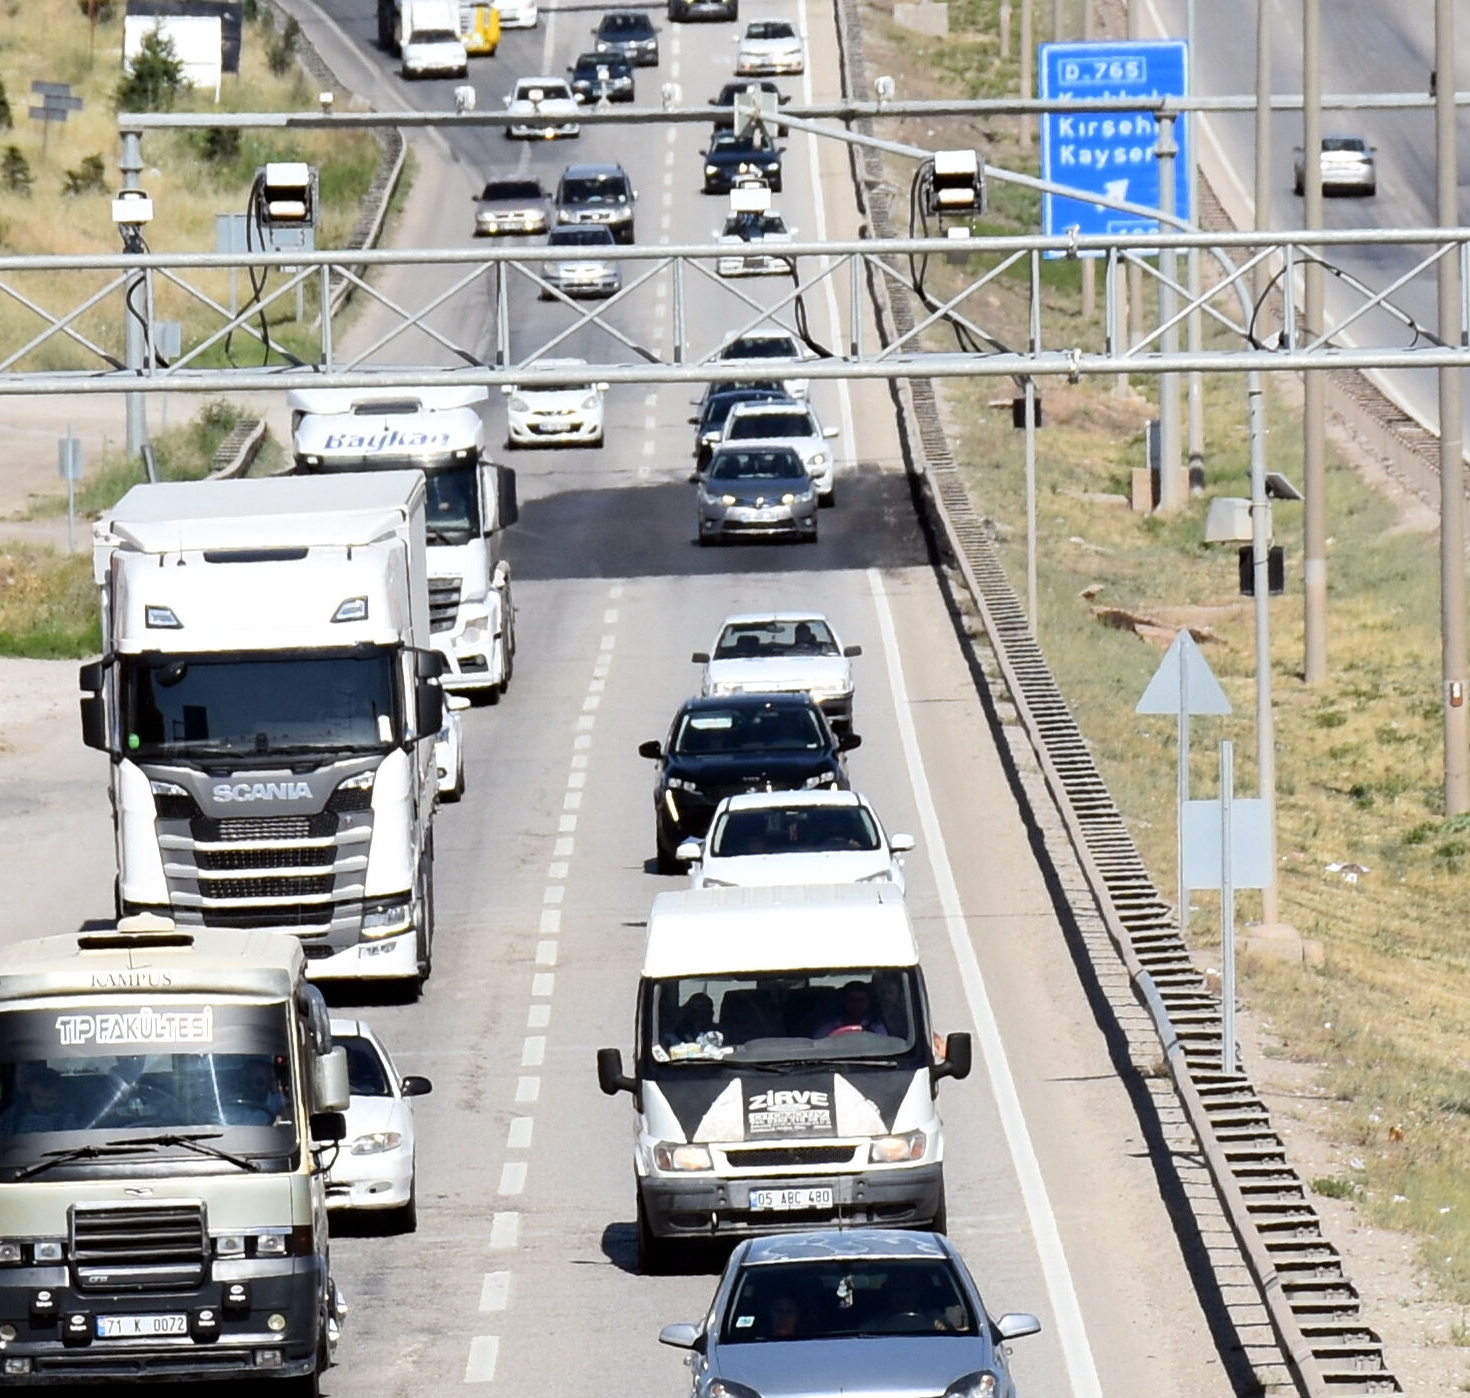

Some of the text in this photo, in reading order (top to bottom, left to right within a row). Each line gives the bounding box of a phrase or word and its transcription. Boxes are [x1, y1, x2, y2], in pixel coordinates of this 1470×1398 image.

[1065, 61, 1139, 81] D.765
[1061, 143, 1154, 169] Kayser
[324, 431, 450, 453] Baykan
[213, 782, 313, 802] SCANIA
[56, 1004, 213, 1045] TIP FAKÜLTESİ
[758, 1190, 830, 1205] 05 ABC 480
[107, 1319, 123, 1333] 71
[134, 1318, 142, 1332] K
[153, 1317, 185, 1332] 0072
